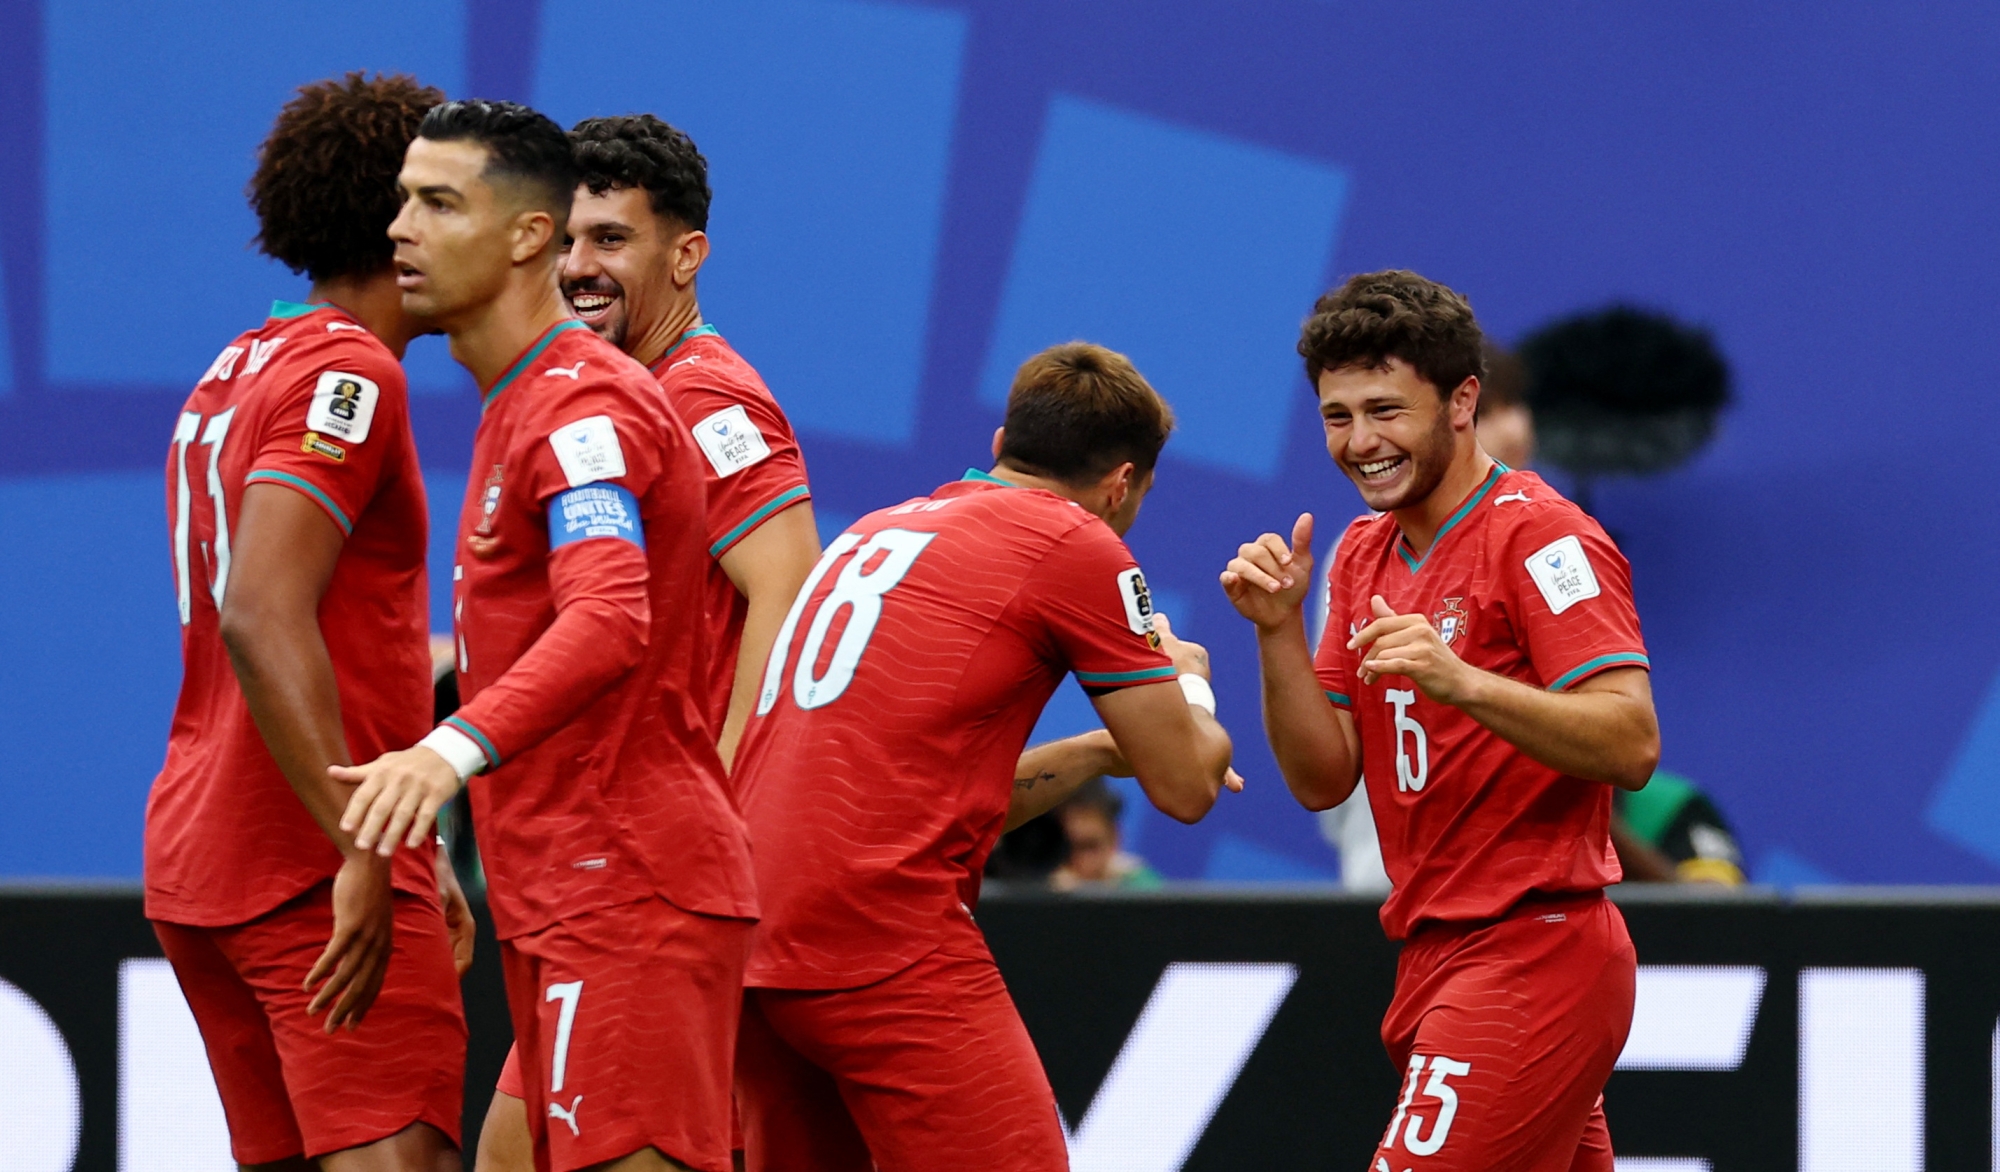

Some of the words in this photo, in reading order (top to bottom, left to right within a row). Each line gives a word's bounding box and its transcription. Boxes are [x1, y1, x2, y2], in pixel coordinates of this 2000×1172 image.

[724, 442, 750, 461] PEACE
[735, 454, 749, 464] FIFA
[563, 501, 628, 520] UNITES
[1557, 575, 1582, 594] PEACE
[1567, 588, 1581, 597] FIFA
[756, 528, 938, 717] 18
[1385, 688, 1429, 792] 15
[545, 980, 585, 1093] 7
[1382, 1053, 1471, 1156] 15
